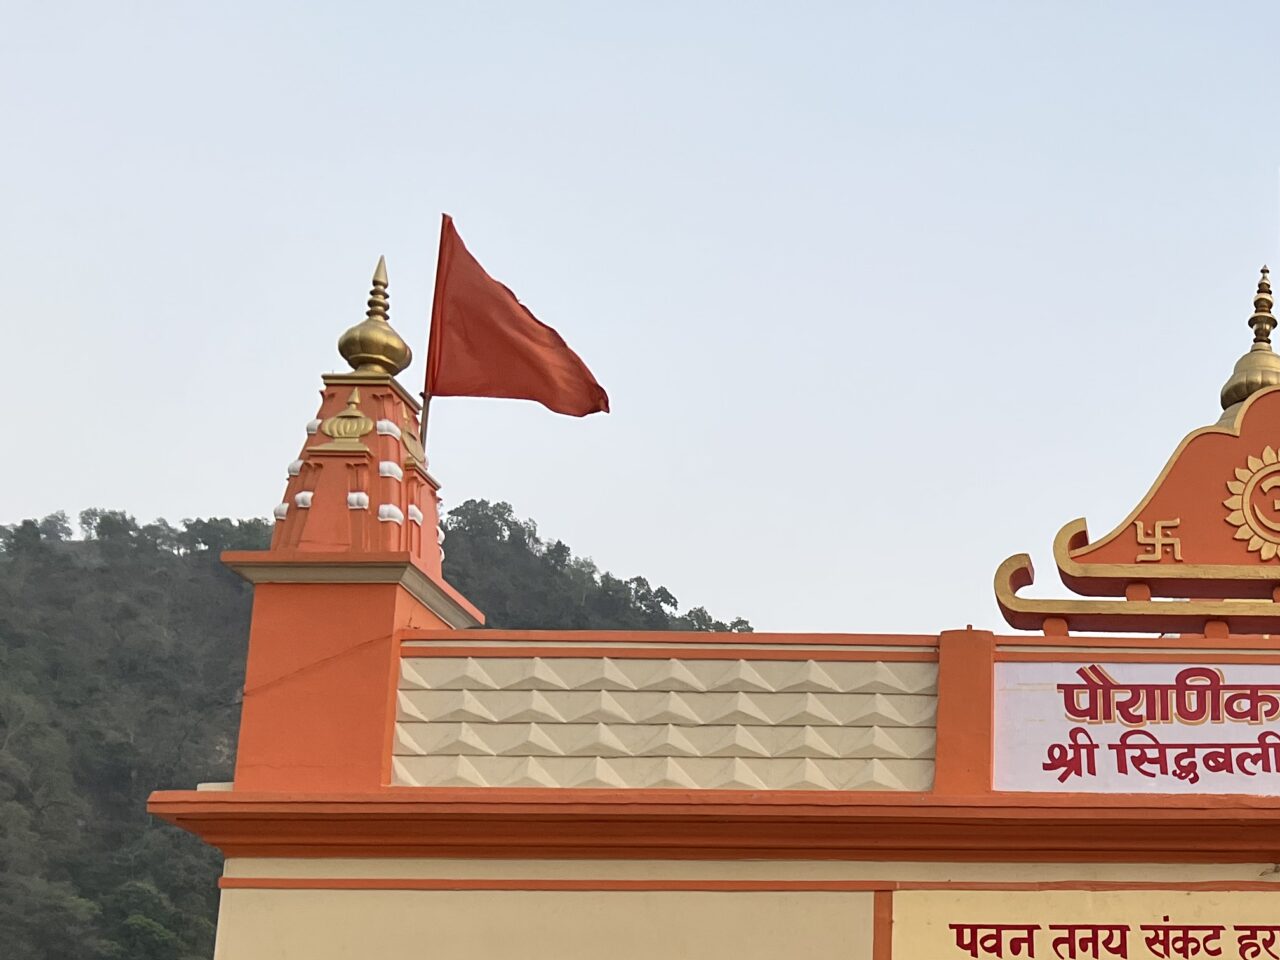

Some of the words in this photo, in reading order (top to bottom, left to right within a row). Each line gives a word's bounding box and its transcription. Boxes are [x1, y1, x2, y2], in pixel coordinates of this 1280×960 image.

[1043, 727, 1099, 783] श्री
[949, 924, 1041, 959] पवन
[1049, 924, 1130, 960] तनय
[1140, 915, 1227, 960] संकट
